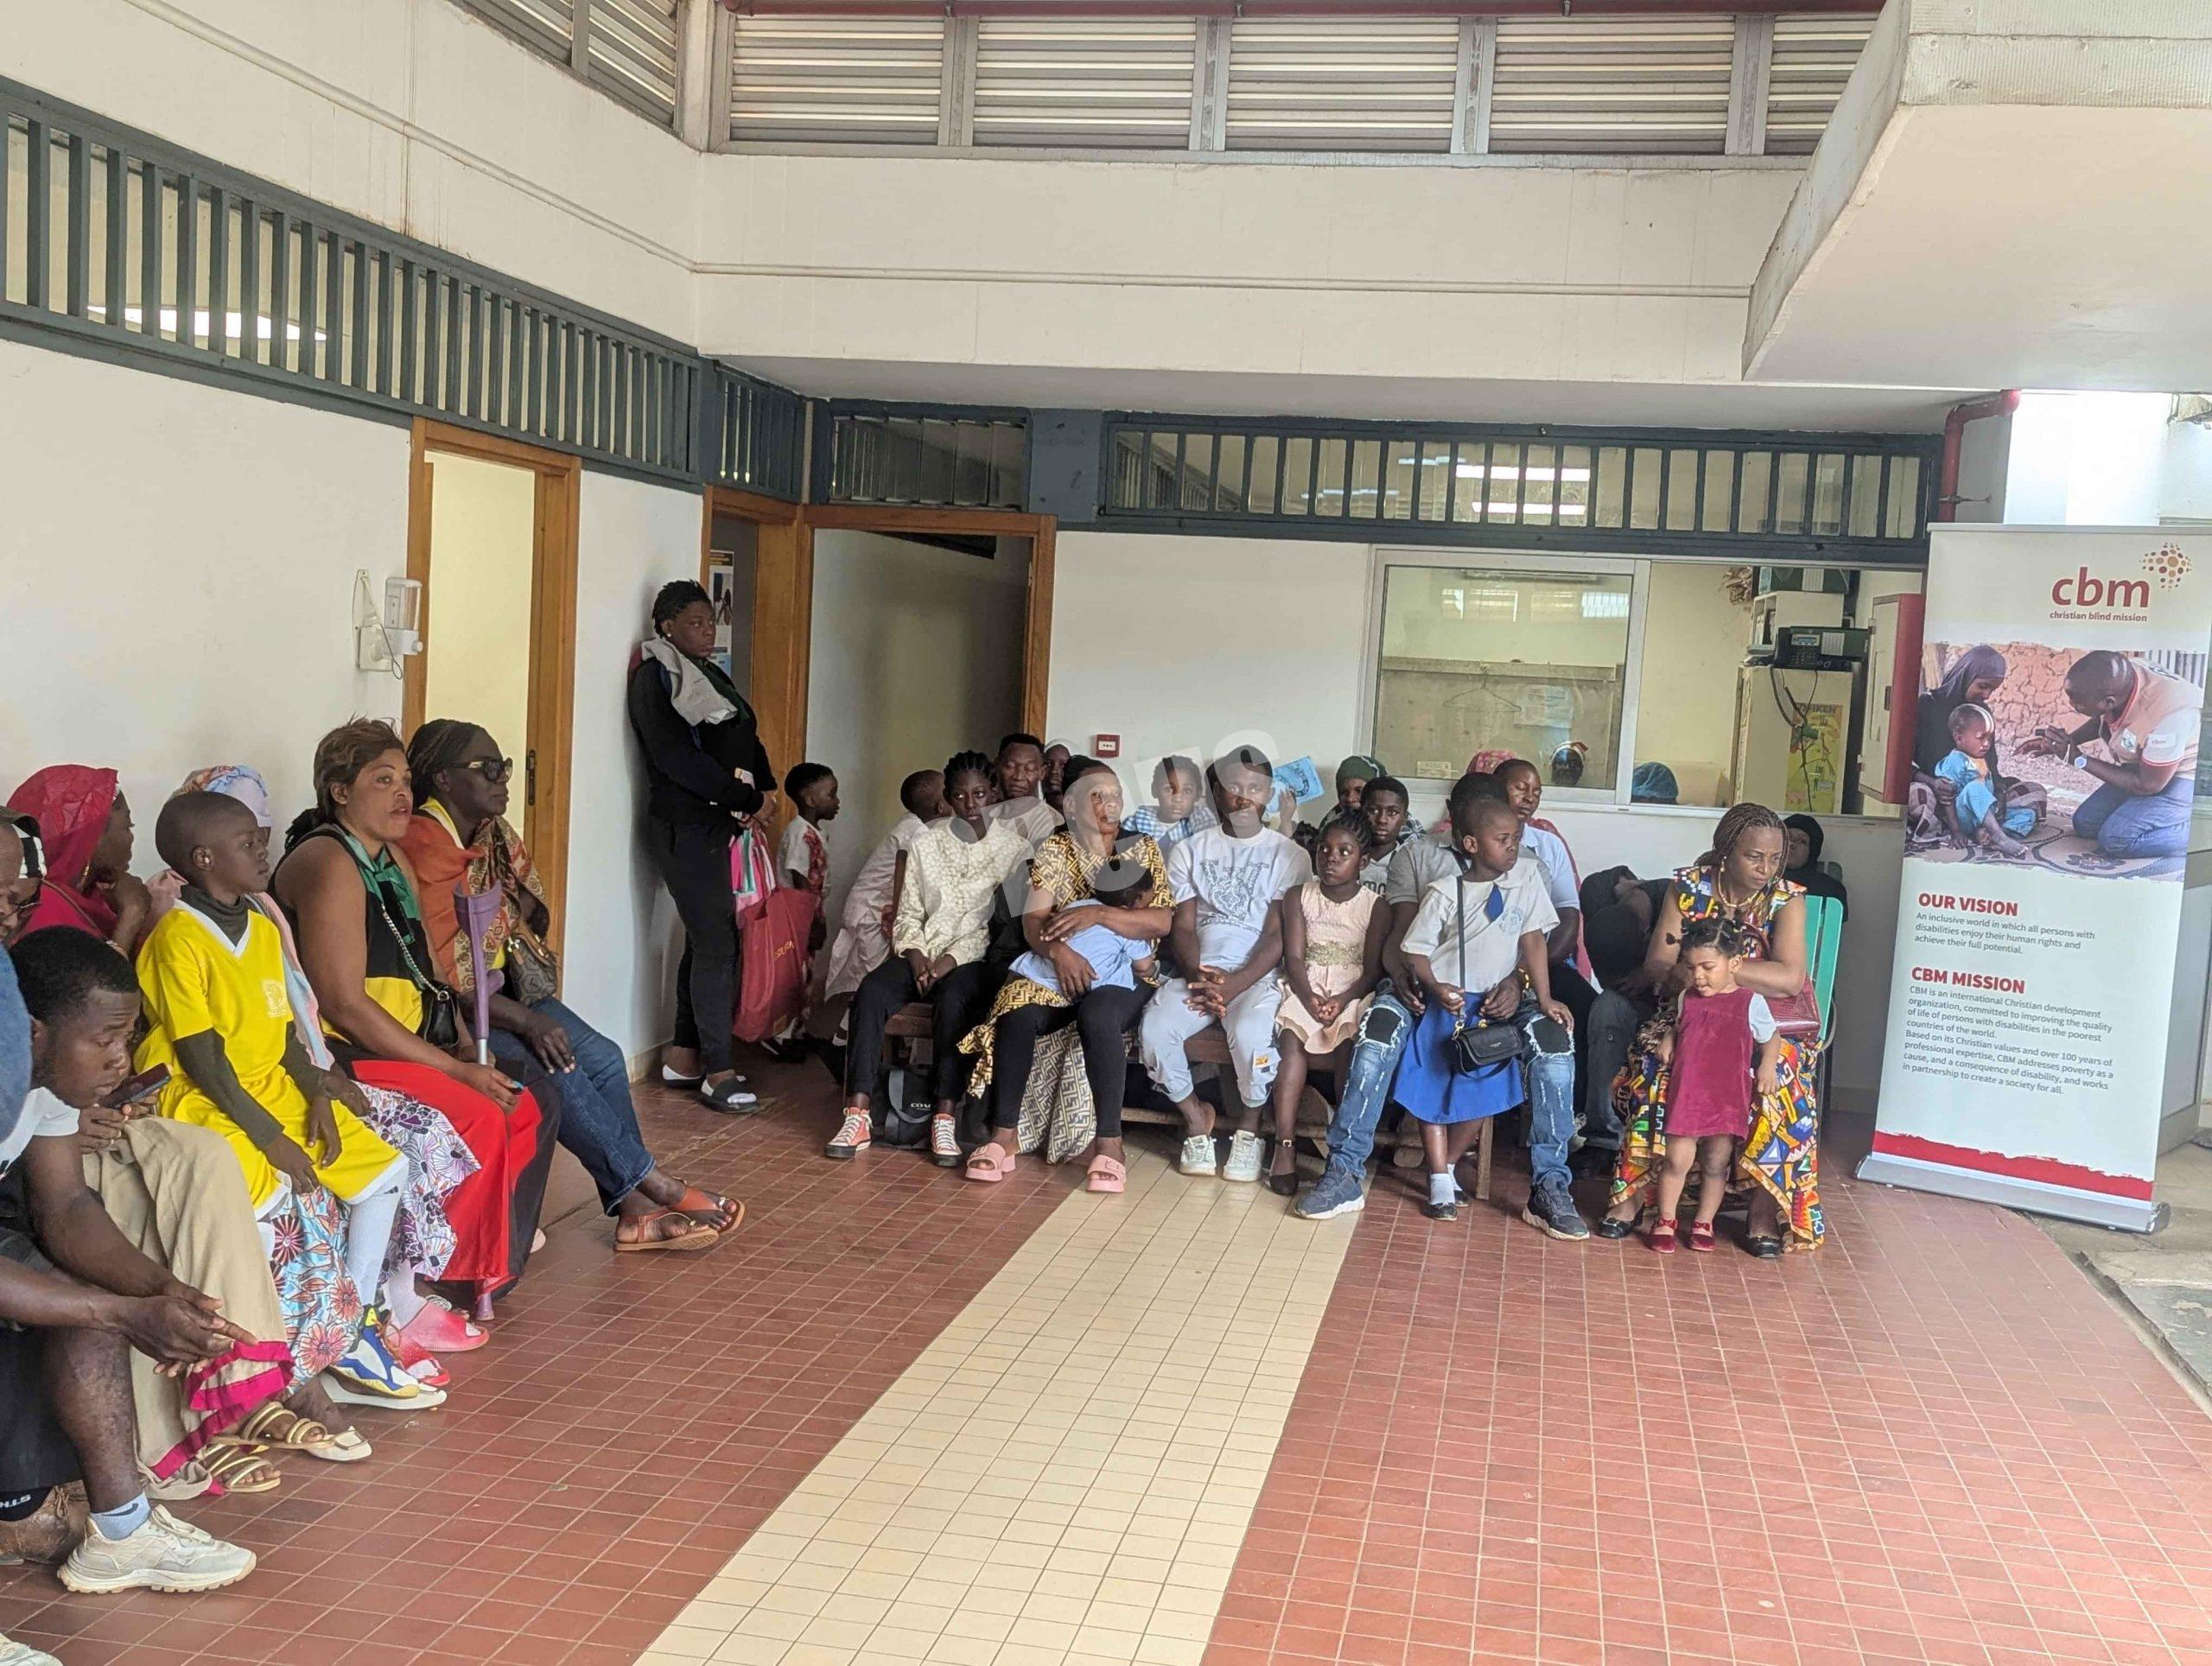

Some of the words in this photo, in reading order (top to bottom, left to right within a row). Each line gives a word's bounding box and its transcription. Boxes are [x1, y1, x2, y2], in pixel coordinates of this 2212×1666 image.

[2052, 567, 2150, 607] cbm
[2050, 611, 2087, 620] christian
[2088, 612, 2111, 620] blind
[1918, 893, 1955, 909] OUR
[1960, 897, 2018, 916] VISION
[1916, 912, 1927, 920] An
[1928, 912, 1965, 925] inclusive
[1966, 919, 1991, 927] world
[1991, 919, 1999, 929] in
[2000, 920, 2026, 932] which
[2027, 925, 2038, 933] all
[2039, 927, 2075, 937] persons
[2075, 931, 2097, 939] with
[1916, 923, 1959, 935] disabilities
[1960, 930, 1984, 939] enjoy
[1985, 931, 2005, 940] their
[2005, 932, 2037, 944] human
[2037, 938, 2063, 948] rights
[2063, 941, 2082, 950] and
[1915, 934, 1946, 944] achieve
[1947, 938, 1967, 947] their
[1967, 939, 1981, 949] full
[1982, 943, 2023, 954] potential.
[1911, 966, 1948, 983] CBM
[1952, 972, 2024, 993] MISSION
[1908, 985, 1927, 995] CBM
[1929, 988, 1936, 996] is
[1949, 991, 2003, 1005] international
[2004, 998, 2043, 1010] Christian
[2043, 1003, 2102, 1018] development
[1909, 998, 1962, 1012] organization,
[1962, 1005, 2009, 1017] committed
[2009, 1010, 2019, 1019] to
[2020, 1012, 2064, 1027] improving
[2065, 1018, 2081, 1027] the
[2082, 1021, 2112, 1033] quality
[1907, 1020, 1945, 1031] countries
[1955, 1025, 1970, 1034] the
[1970, 1029, 1996, 1038] world.
[1908, 1007, 1916, 1015] of
[1916, 1008, 1930, 1018] life
[1930, 1010, 1940, 1019] of
[1941, 1014, 1974, 1023] persons
[1974, 1018, 1993, 1027] with
[1994, 1020, 2040, 1033] disabilities
[2041, 1025, 2050, 1034] in
[2051, 1027, 2067, 1037] the
[2067, 1031, 2103, 1042] poorest
[1905, 1042, 1954, 1054] professional
[1955, 1049, 1995, 1062] expertise,
[1996, 1053, 2016, 1063] CBM
[2017, 1058, 2060, 1071] addresses
[2061, 1065, 2094, 1078] poverty
[1906, 1029, 1930, 1040] Based
[1943, 1034, 1955, 1044] its
[1955, 1036, 1993, 1049] Christian
[1993, 1043, 2021, 1053] values
[2021, 1047, 2039, 1056] and
[2039, 1050, 2060, 1059] over
[2061, 1052, 2076, 1061] 100
[2077, 1056, 2101, 1065] years
[1903, 1061, 1910, 1070] in
[1910, 1065, 1959, 1078] partnership
[1970, 1074, 1997, 1084] create
[2005, 1079, 2035, 1091] society
[2036, 1082, 2050, 1091] for
[1904, 1052, 1929, 1063] cause,
[1954, 1060, 2009, 1074] consequence
[2009, 1067, 2019, 1076] of
[2019, 1069, 2062, 1084] disability,
[2063, 1077, 2081, 1085] and
[2082, 1080, 2108, 1090] works
